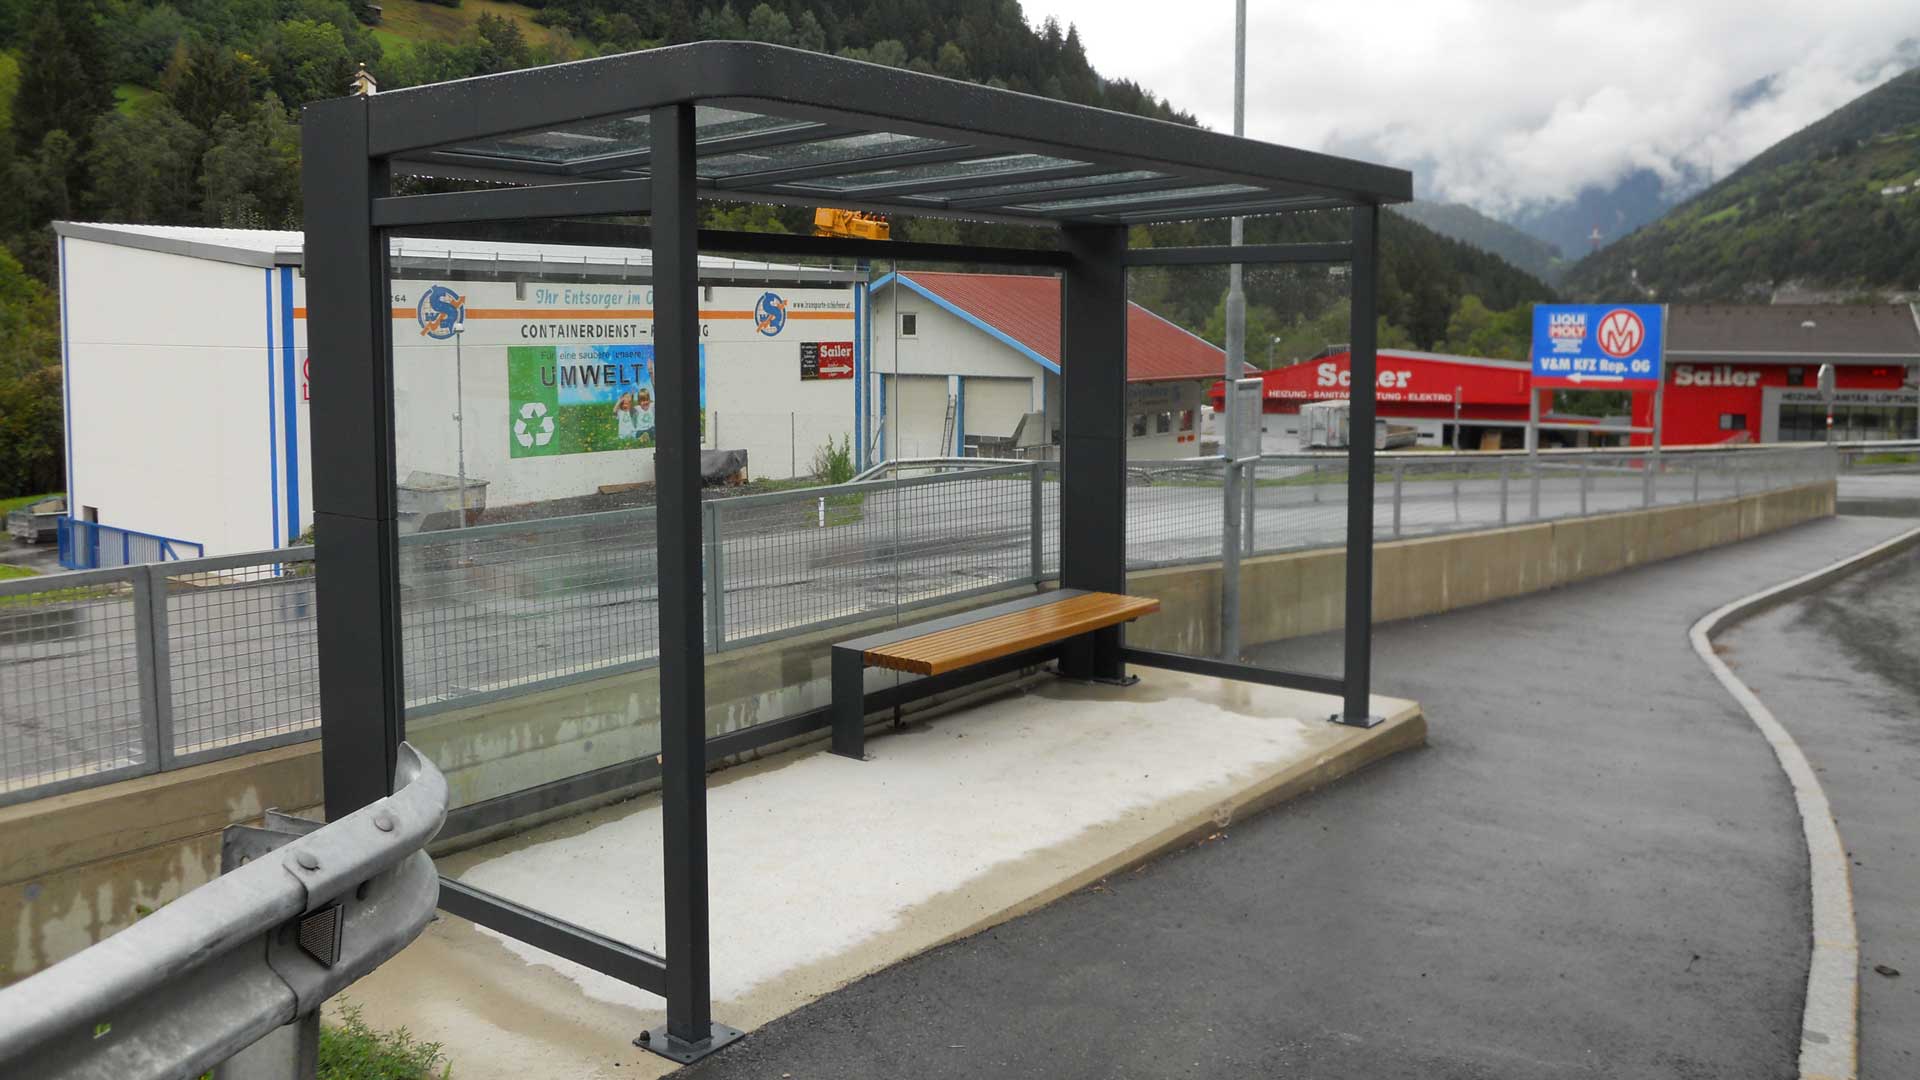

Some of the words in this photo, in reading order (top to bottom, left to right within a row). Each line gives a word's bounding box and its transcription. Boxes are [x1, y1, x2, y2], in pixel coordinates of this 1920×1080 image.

[391, 295, 407, 303] 64
[535, 288, 559, 305] Ihr
[564, 289, 621, 309] Entsorger
[627, 290, 641, 305] im
[1551, 313, 1586, 325] LIQUI
[520, 324, 638, 339] CONTAINERDIENST
[1550, 325, 1586, 338] MOLY
[559, 352, 577, 361] eine
[578, 350, 610, 361] saubere
[820, 345, 852, 358] Sailer
[1541, 358, 1572, 371] V&M
[1574, 358, 1598, 371] KFZ
[1600, 358, 1629, 374] Rep.
[1631, 360, 1651, 373] OG
[541, 363, 644, 388] UMWELT
[1317, 363, 1412, 388] Saer
[1674, 365, 1761, 387] Sailer
[1269, 390, 1307, 399] HEIZUNG
[1376, 391, 1401, 400] TUNG
[1408, 393, 1453, 402] ELEKTRO
